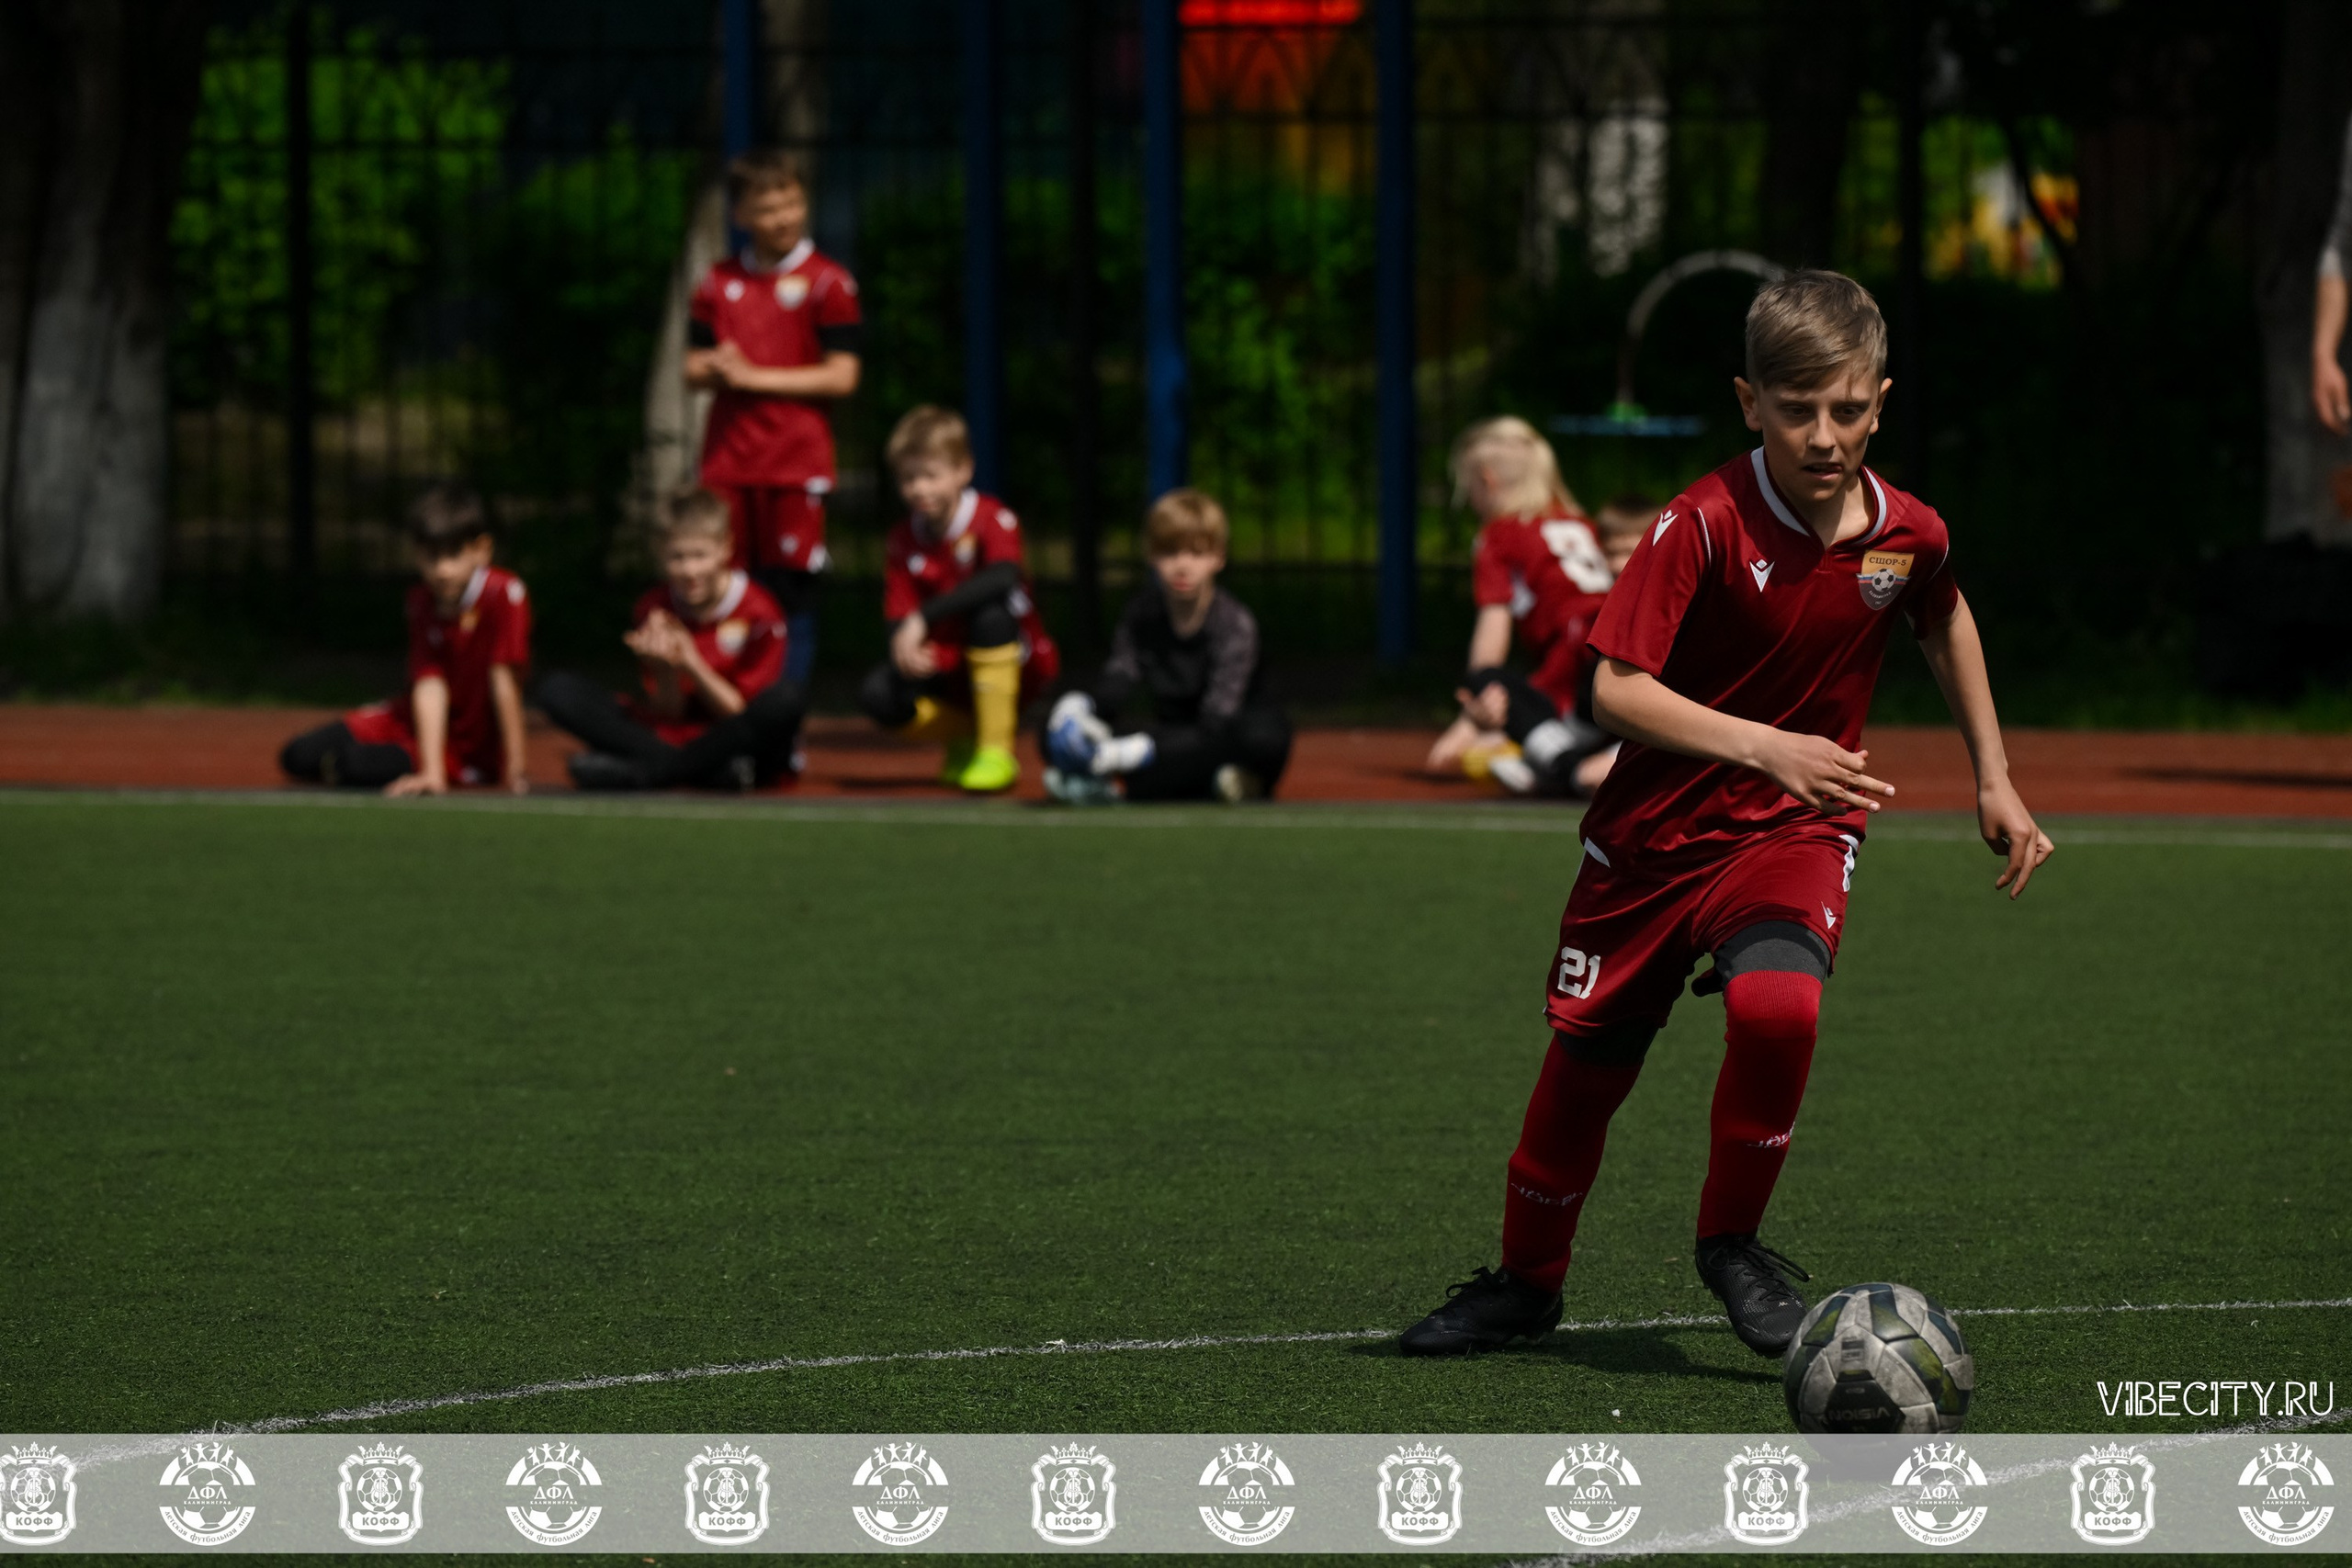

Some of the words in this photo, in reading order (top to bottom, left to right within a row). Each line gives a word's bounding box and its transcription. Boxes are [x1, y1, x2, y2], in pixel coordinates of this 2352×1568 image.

[1869, 557, 1907, 567] СШОР-5
[1557, 946, 1600, 999] 21
[1827, 1406, 1892, 1422] VISION
